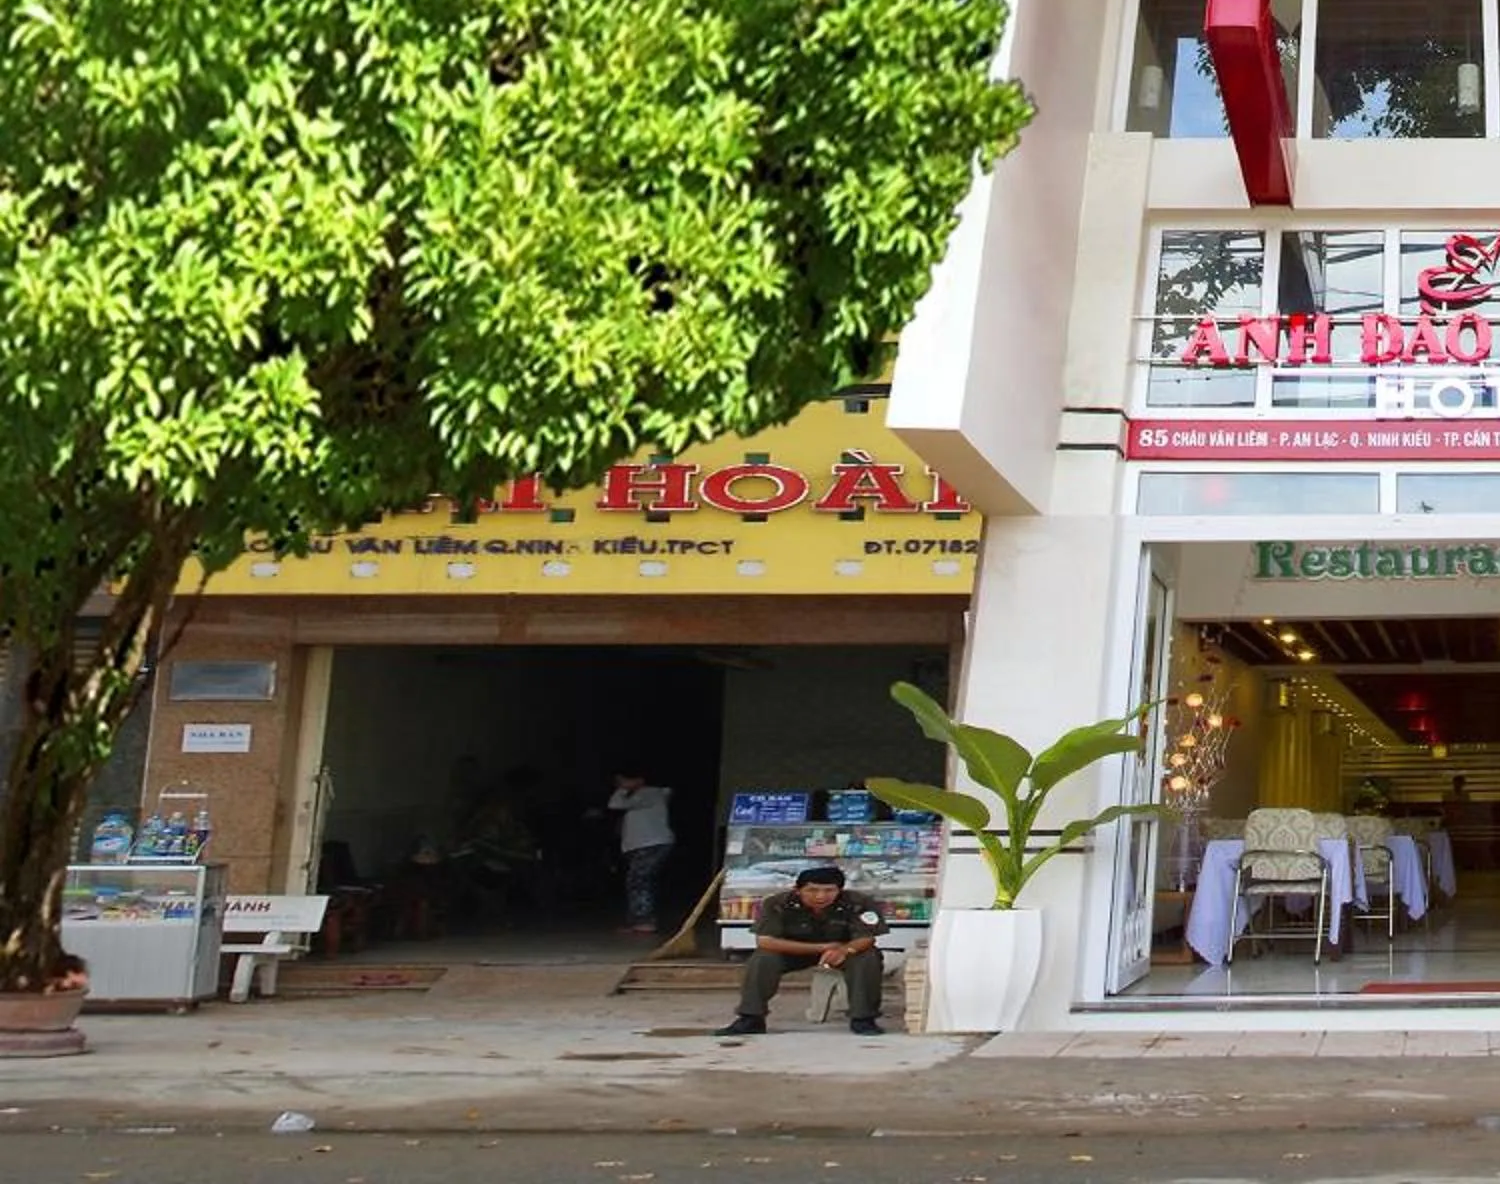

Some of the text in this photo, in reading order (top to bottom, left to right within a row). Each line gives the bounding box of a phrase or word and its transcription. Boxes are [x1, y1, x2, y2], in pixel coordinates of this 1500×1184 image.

[1181, 312, 1332, 364] ANH
[1138, 428, 1169, 448] 85
[1367, 431, 1400, 447] NINH
